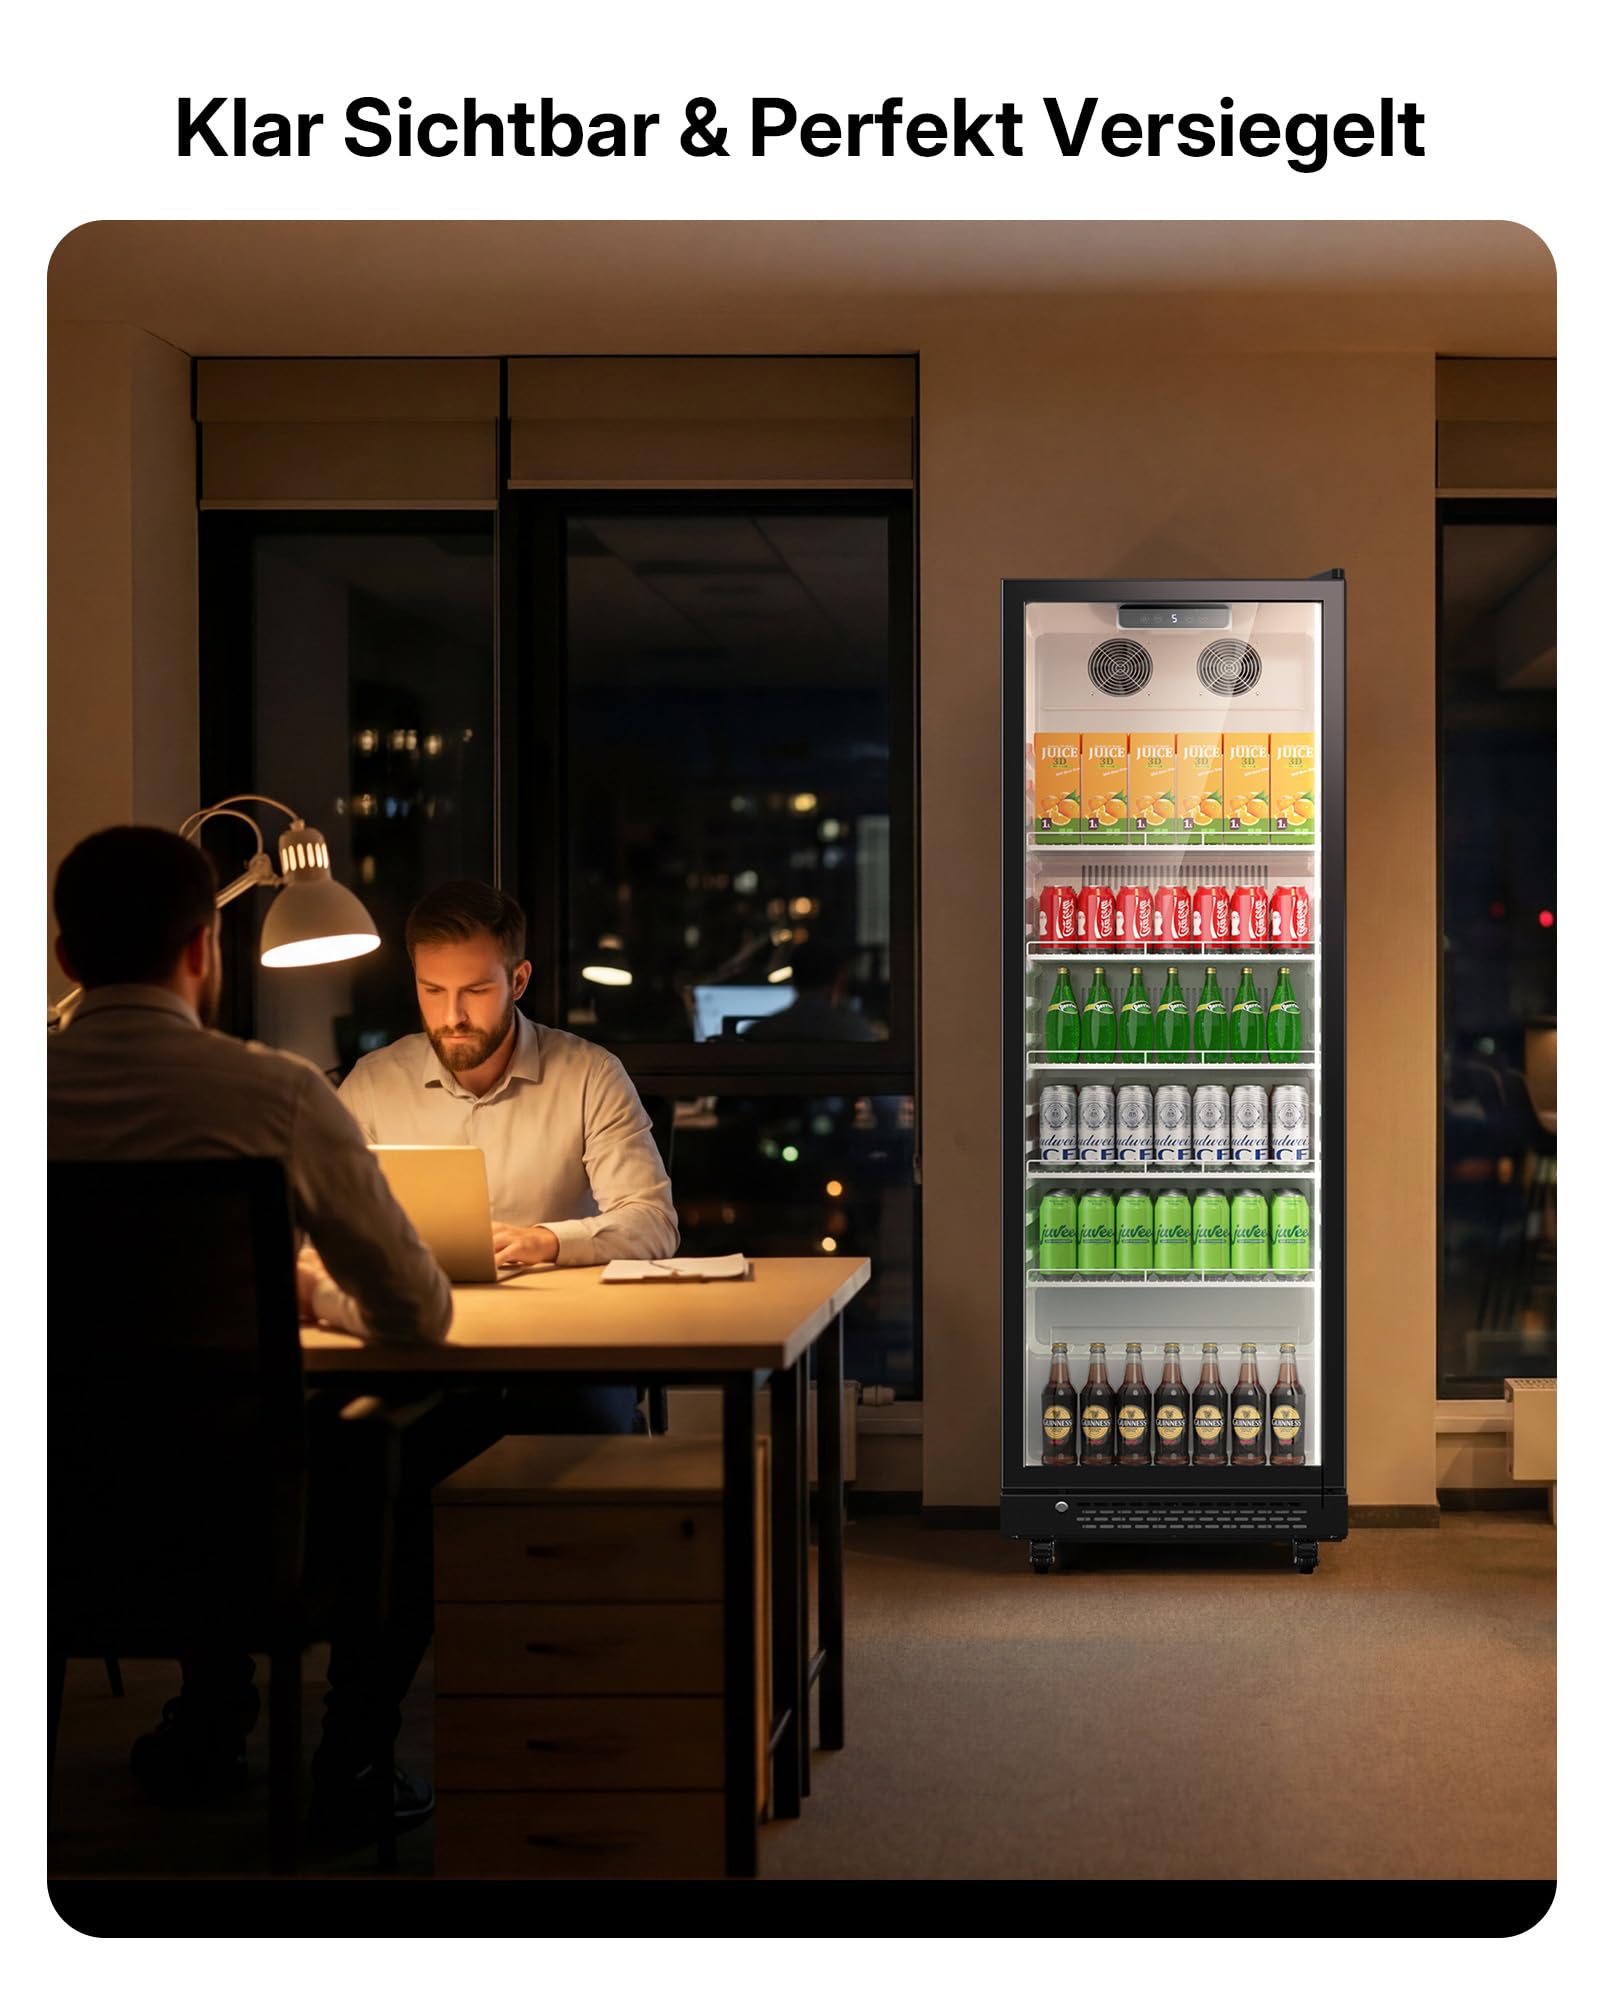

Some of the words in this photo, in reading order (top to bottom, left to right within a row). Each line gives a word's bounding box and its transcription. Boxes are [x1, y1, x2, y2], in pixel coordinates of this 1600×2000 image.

[1041, 746, 1078, 760] JUICE
[1088, 746, 1125, 760] JUICE
[1136, 746, 1173, 760] JUICE
[1183, 746, 1220, 760] JUICE
[1230, 746, 1267, 760] JUICE
[1277, 746, 1313, 760] JUICE
[1053, 757, 1067, 766] 3D
[1100, 757, 1114, 766] 3D
[1043, 1418, 1073, 1427] GUINNESS
[1081, 1418, 1111, 1427] GUINNESS
[1118, 1418, 1148, 1427] GUINNESS
[1156, 1418, 1186, 1427] GUINNESS
[1194, 1418, 1224, 1427] GUINNESS
[1232, 1418, 1262, 1427] GUINNESS
[1271, 1418, 1301, 1427] GUINNESS
